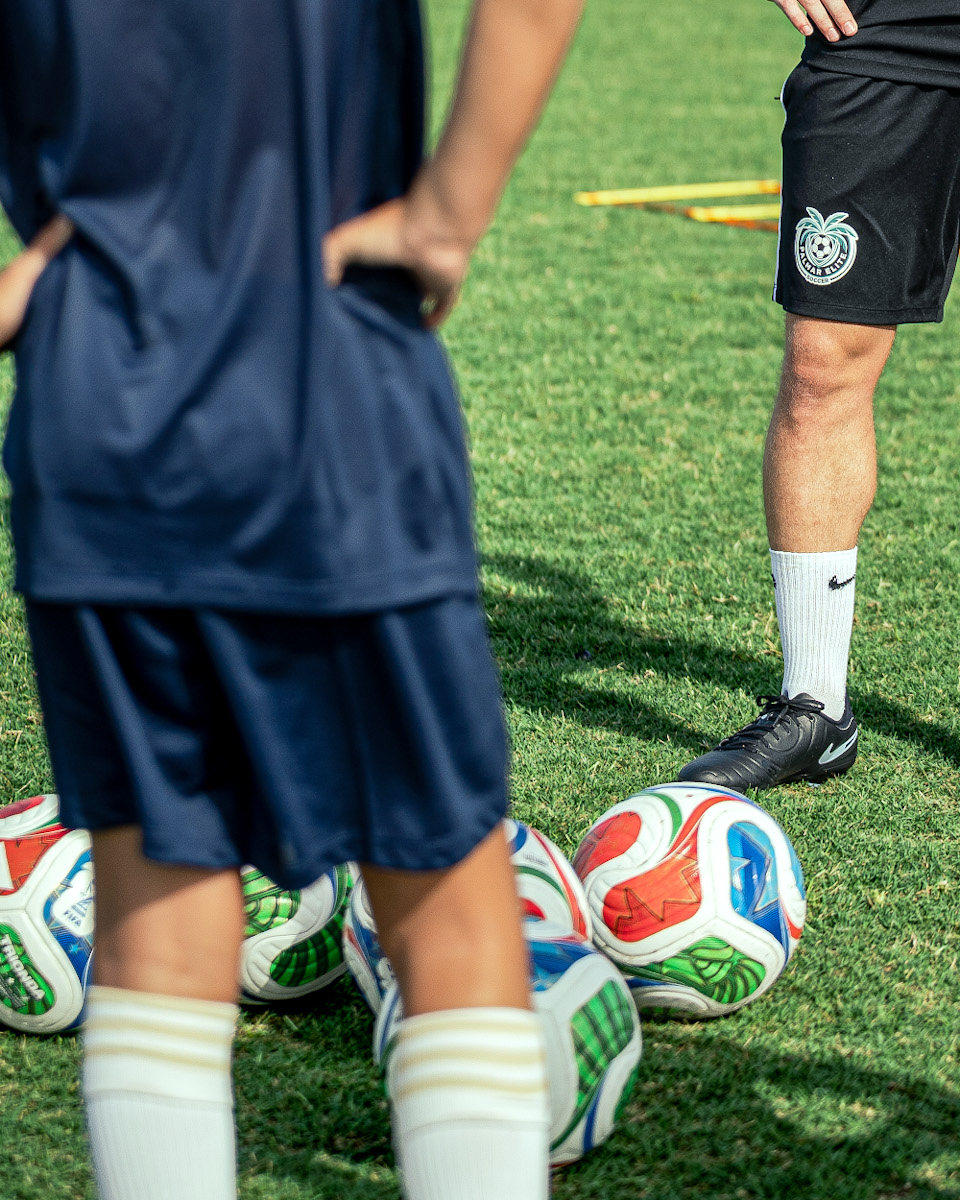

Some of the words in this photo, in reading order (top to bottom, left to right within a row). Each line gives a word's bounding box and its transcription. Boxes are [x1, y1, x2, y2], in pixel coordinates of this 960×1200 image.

[799, 246, 822, 276] PALMAR
[824, 253, 848, 275] ELITE
[806, 274, 830, 284] SOCCER
[63, 909, 82, 927] FIFA
[0, 933, 46, 1002] TRIONDA
